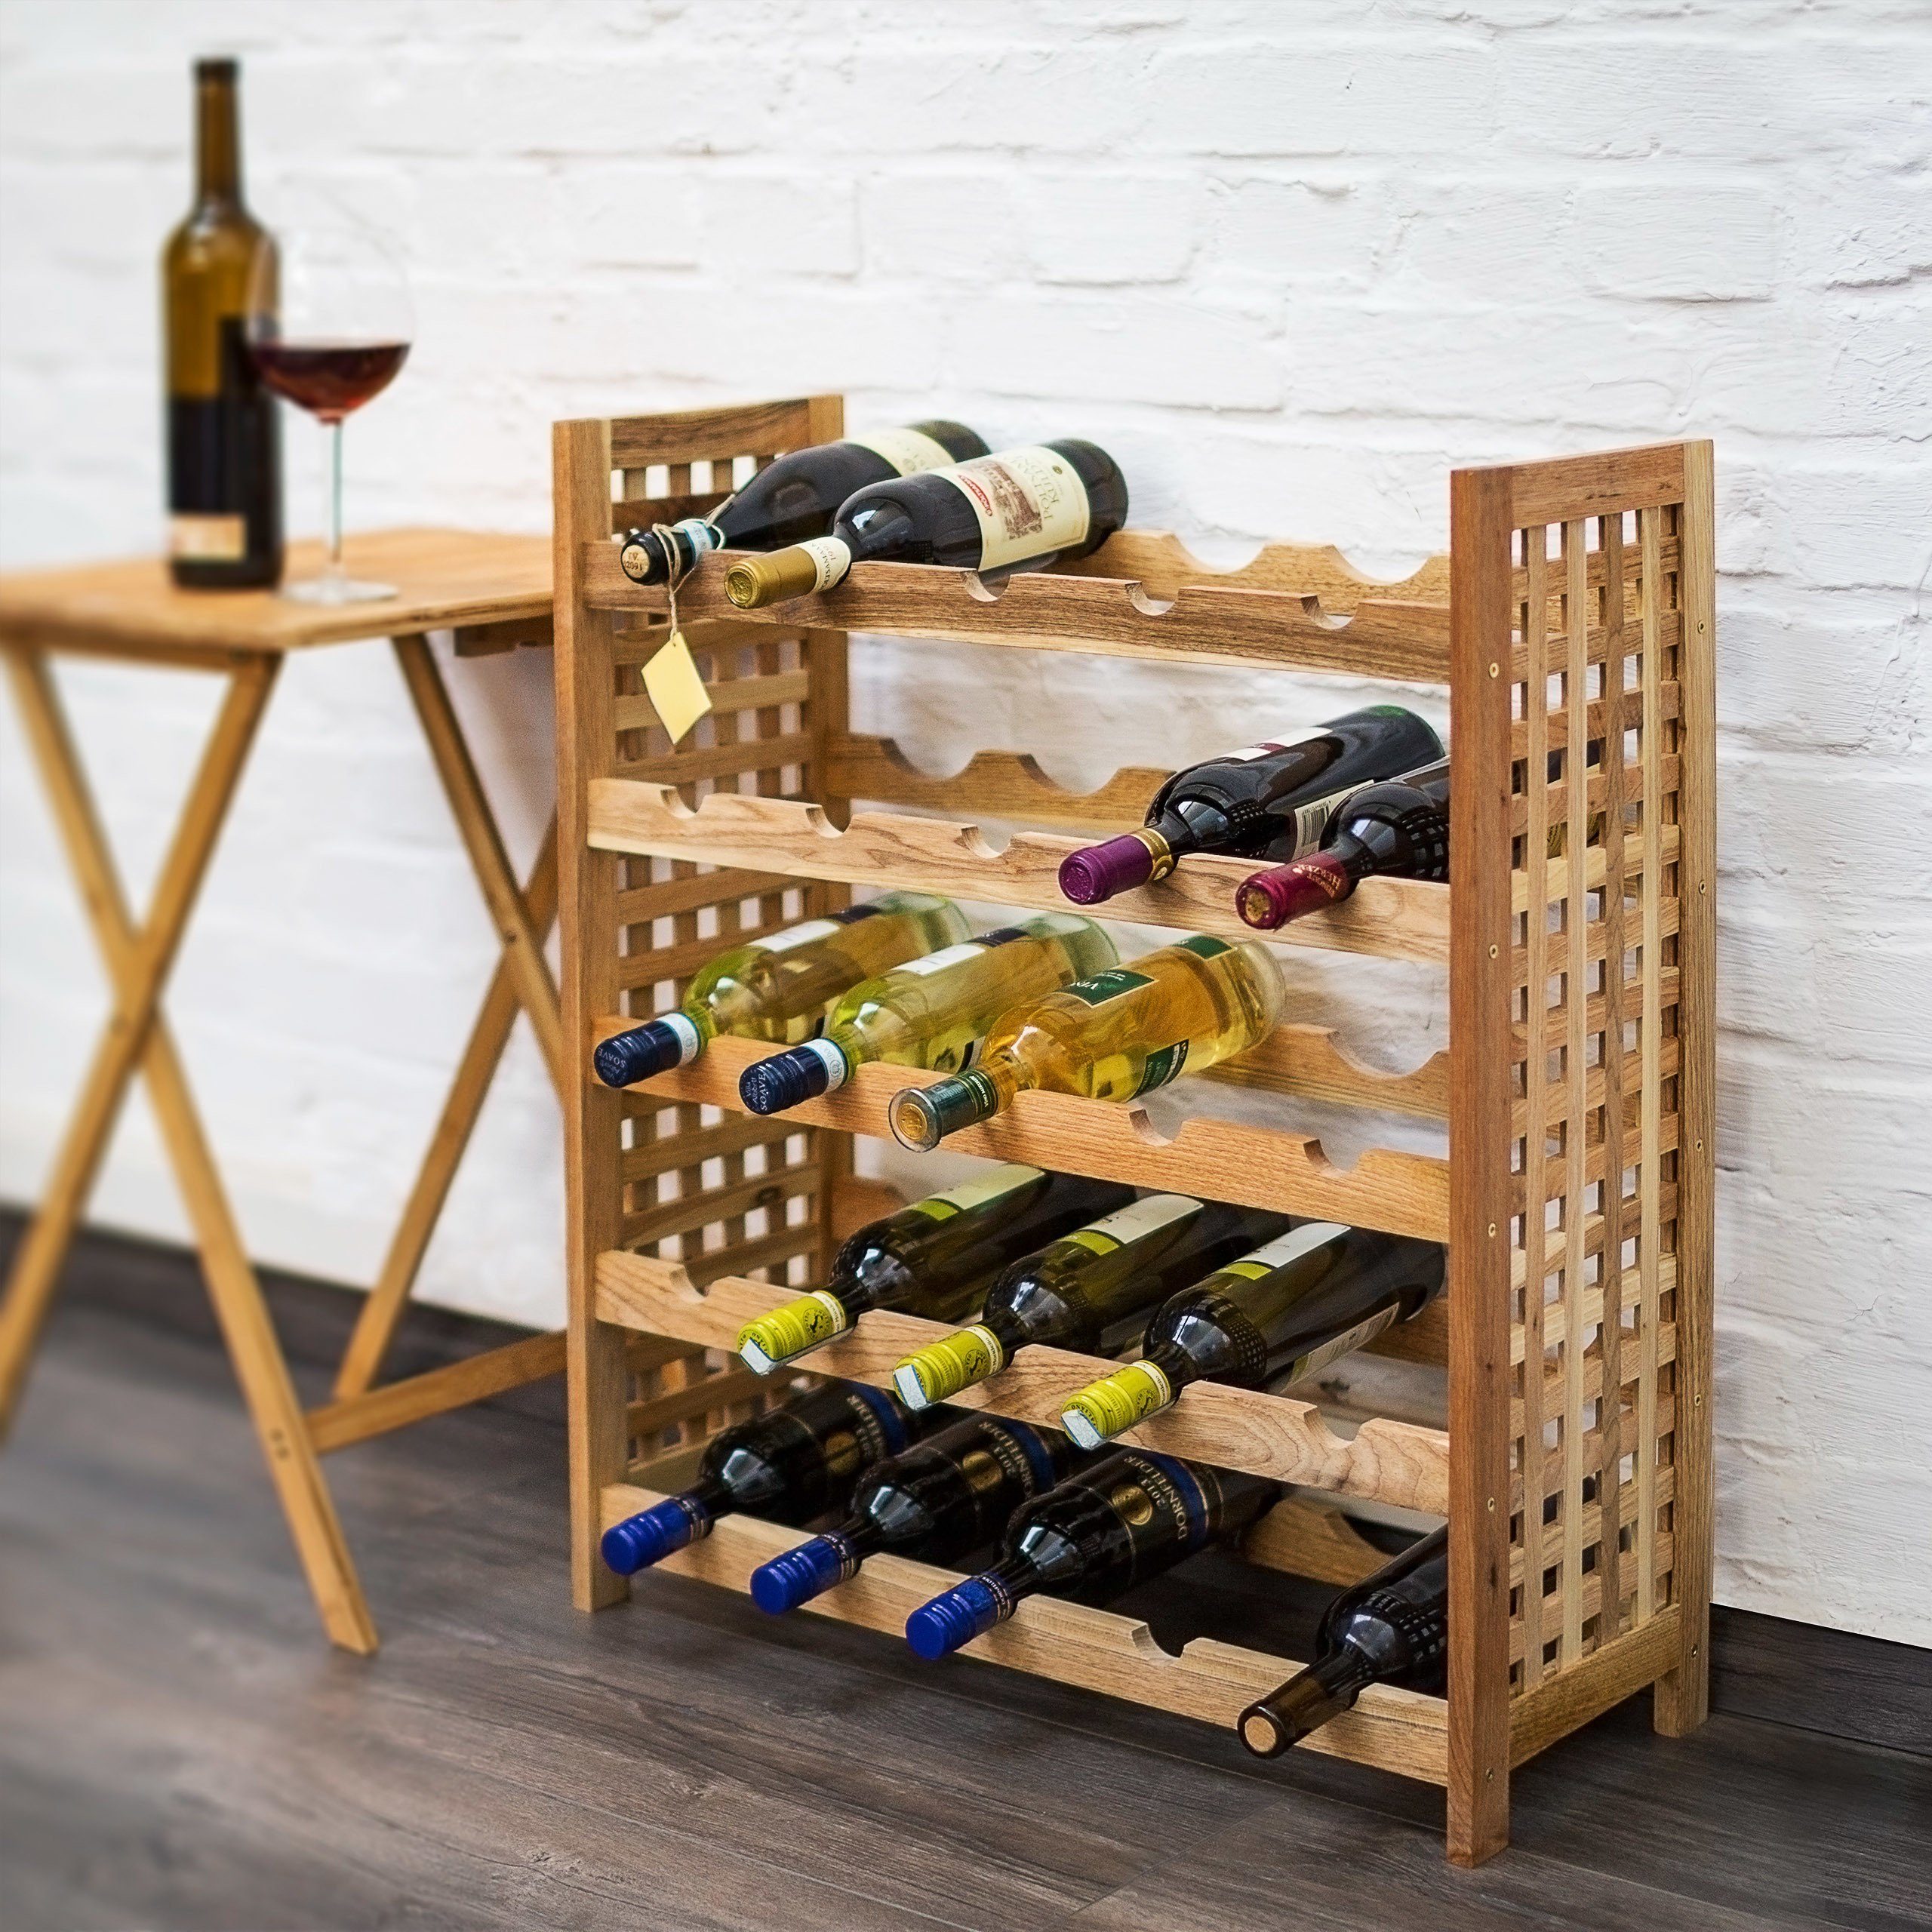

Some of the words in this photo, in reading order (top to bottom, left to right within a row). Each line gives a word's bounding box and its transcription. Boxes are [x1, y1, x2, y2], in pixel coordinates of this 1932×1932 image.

[598, 1047, 626, 1069] SOAVE
[758, 1073, 768, 1111] SOAVE
[1124, 1456, 1188, 1540] DORNFELDER
